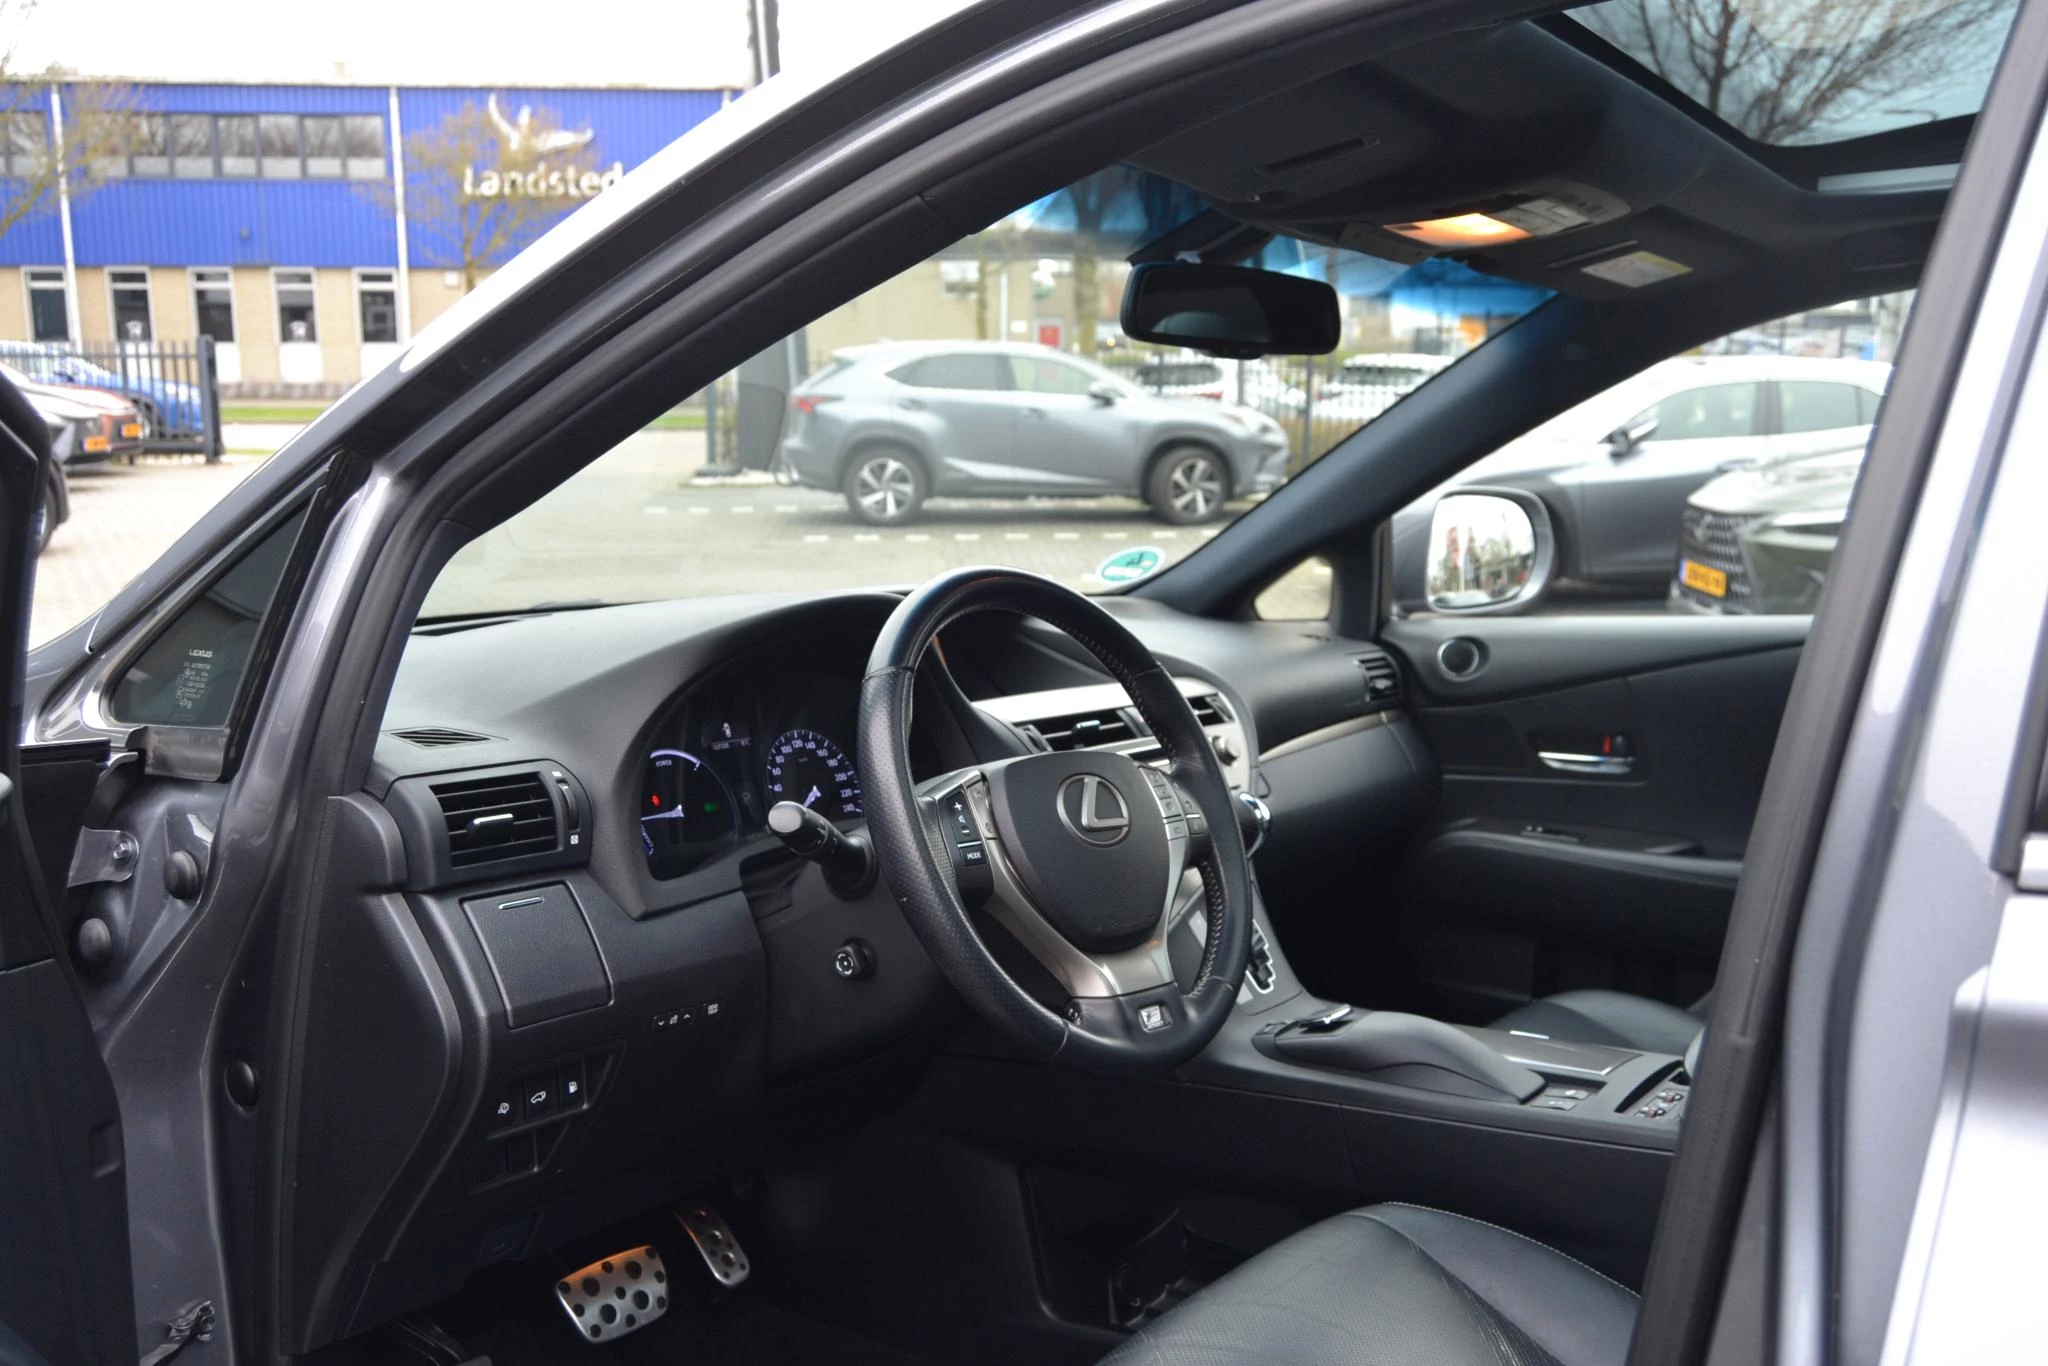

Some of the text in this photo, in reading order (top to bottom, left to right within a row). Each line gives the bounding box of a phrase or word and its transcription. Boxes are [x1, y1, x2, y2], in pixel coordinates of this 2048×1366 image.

[189, 649, 213, 658] LEXUS
[792, 740, 803, 748] 120
[805, 741, 815, 749] 140
[781, 745, 792, 754] 100
[817, 748, 828, 757] 160
[775, 755, 784, 764] 80
[827, 758, 838, 767] 180
[772, 767, 781, 776] 60
[834, 772, 847, 782] 200
[967, 851, 982, 860] MODE
